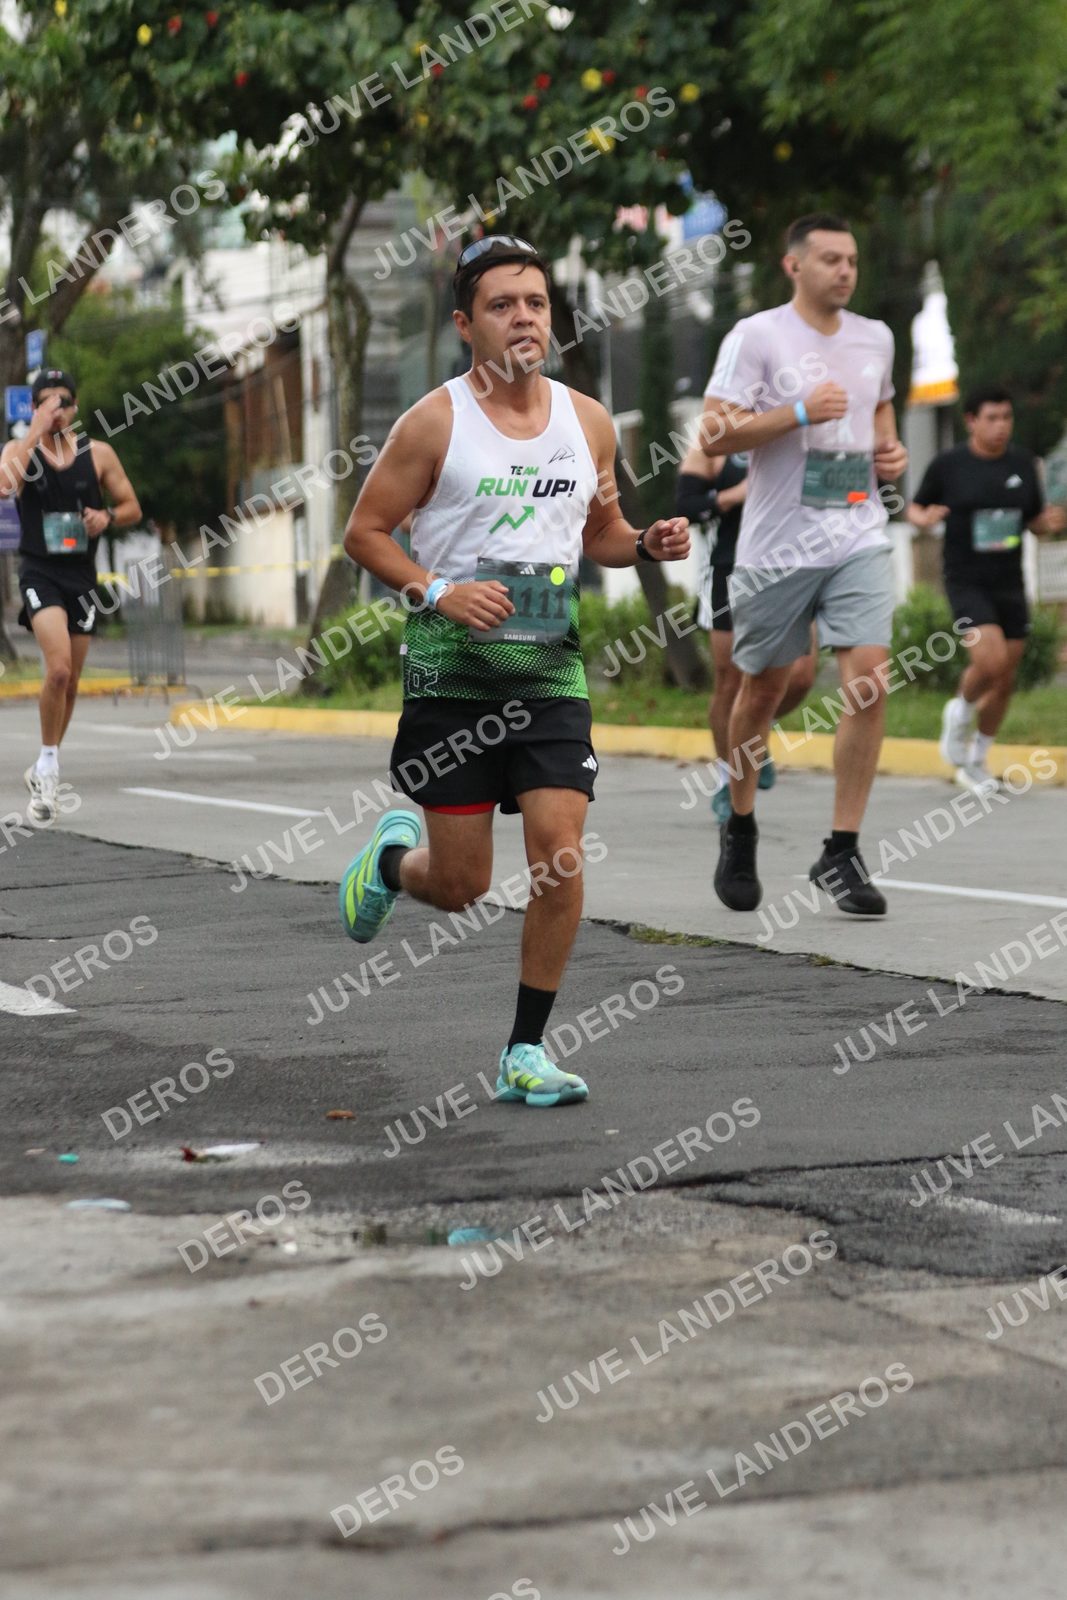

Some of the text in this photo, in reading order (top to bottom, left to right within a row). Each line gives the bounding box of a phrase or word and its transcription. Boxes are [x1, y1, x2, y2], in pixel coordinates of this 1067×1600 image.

[475, 477, 577, 498] RUN UP!
[503, 632, 537, 642] SAMSUNG
